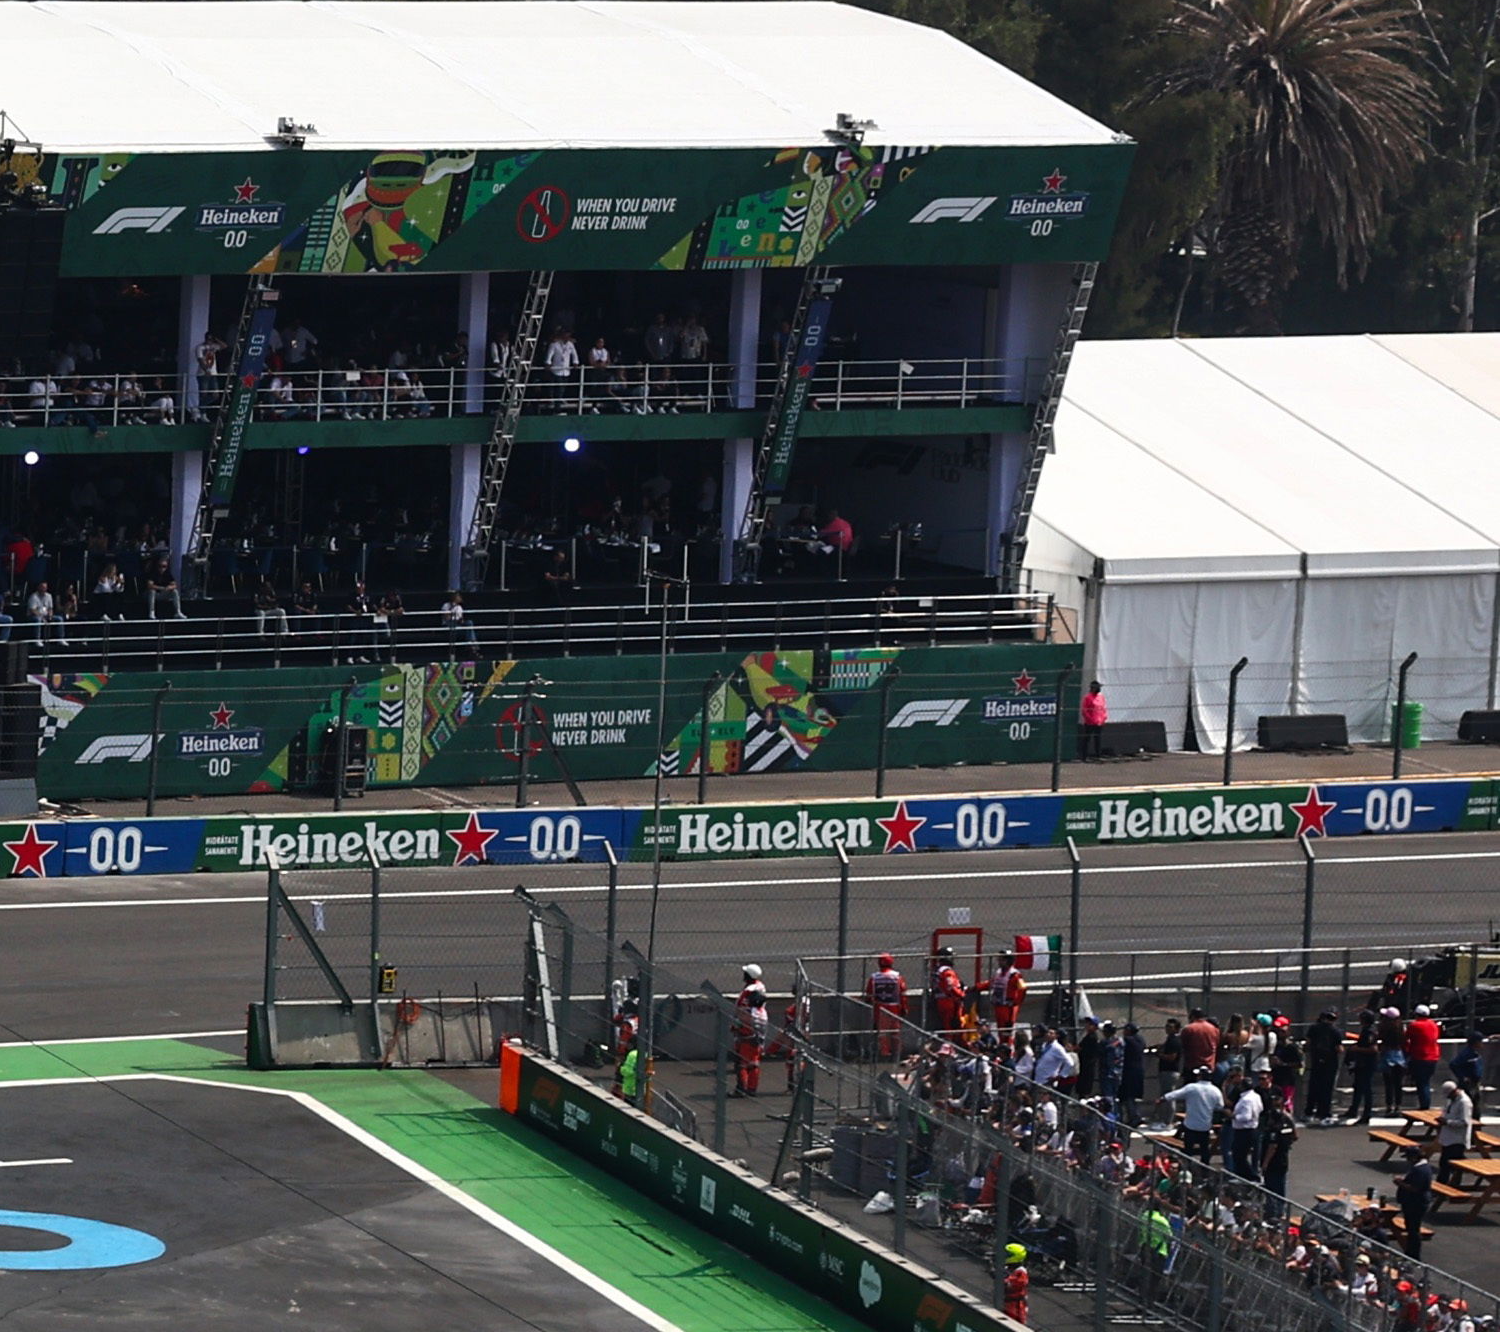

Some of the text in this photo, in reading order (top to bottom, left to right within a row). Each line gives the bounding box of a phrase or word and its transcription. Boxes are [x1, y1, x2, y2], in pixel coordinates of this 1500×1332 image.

[577, 198, 677, 212] WHEN YOU DRIVE
[1010, 198, 1082, 214] Heineken
[201, 208, 280, 224] Heineken
[571, 216, 648, 230] NEVER DRINK
[1031, 220, 1052, 236] 0.0
[225, 231, 247, 247] 0.0
[774, 383, 806, 463] Heineken
[219, 393, 251, 476] Heineken
[985, 700, 1056, 717] Heineken
[554, 709, 651, 727] WHEN YOU DRIVE
[552, 729, 626, 745] NEVER DRINK
[1010, 722, 1030, 740] 0.0
[182, 733, 259, 752] Heineken
[209, 758, 230, 776] 0.0
[1098, 796, 1284, 839] Heineken
[1366, 788, 1412, 830] 0.0
[957, 803, 1005, 847] 0.0
[530, 816, 580, 860] 0.0
[677, 811, 874, 858] Heineken
[90, 827, 141, 871] 0.0
[239, 822, 439, 869] Heineken
